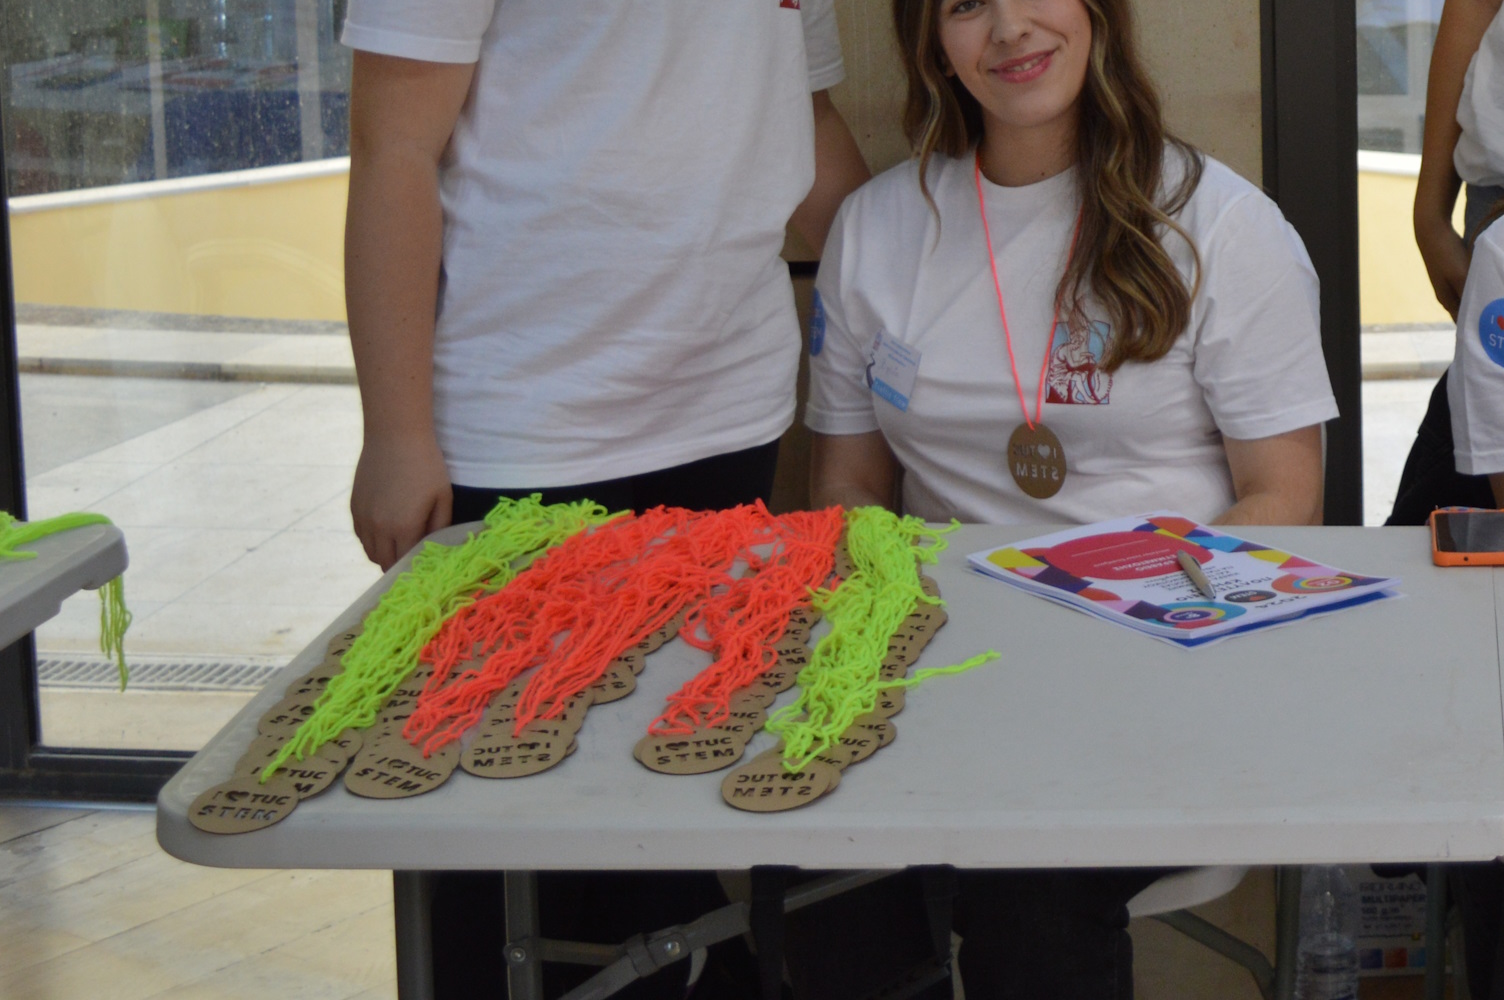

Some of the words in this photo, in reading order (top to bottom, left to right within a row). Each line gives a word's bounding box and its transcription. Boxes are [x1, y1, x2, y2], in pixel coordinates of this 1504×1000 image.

[692, 737, 732, 748] TUC
[656, 748, 735, 765] STEM
[288, 769, 328, 779] TUC
[354, 768, 421, 791] STEM
[405, 766, 441, 780] TUC
[250, 793, 292, 805] TUC
[197, 805, 278, 820] STEM
